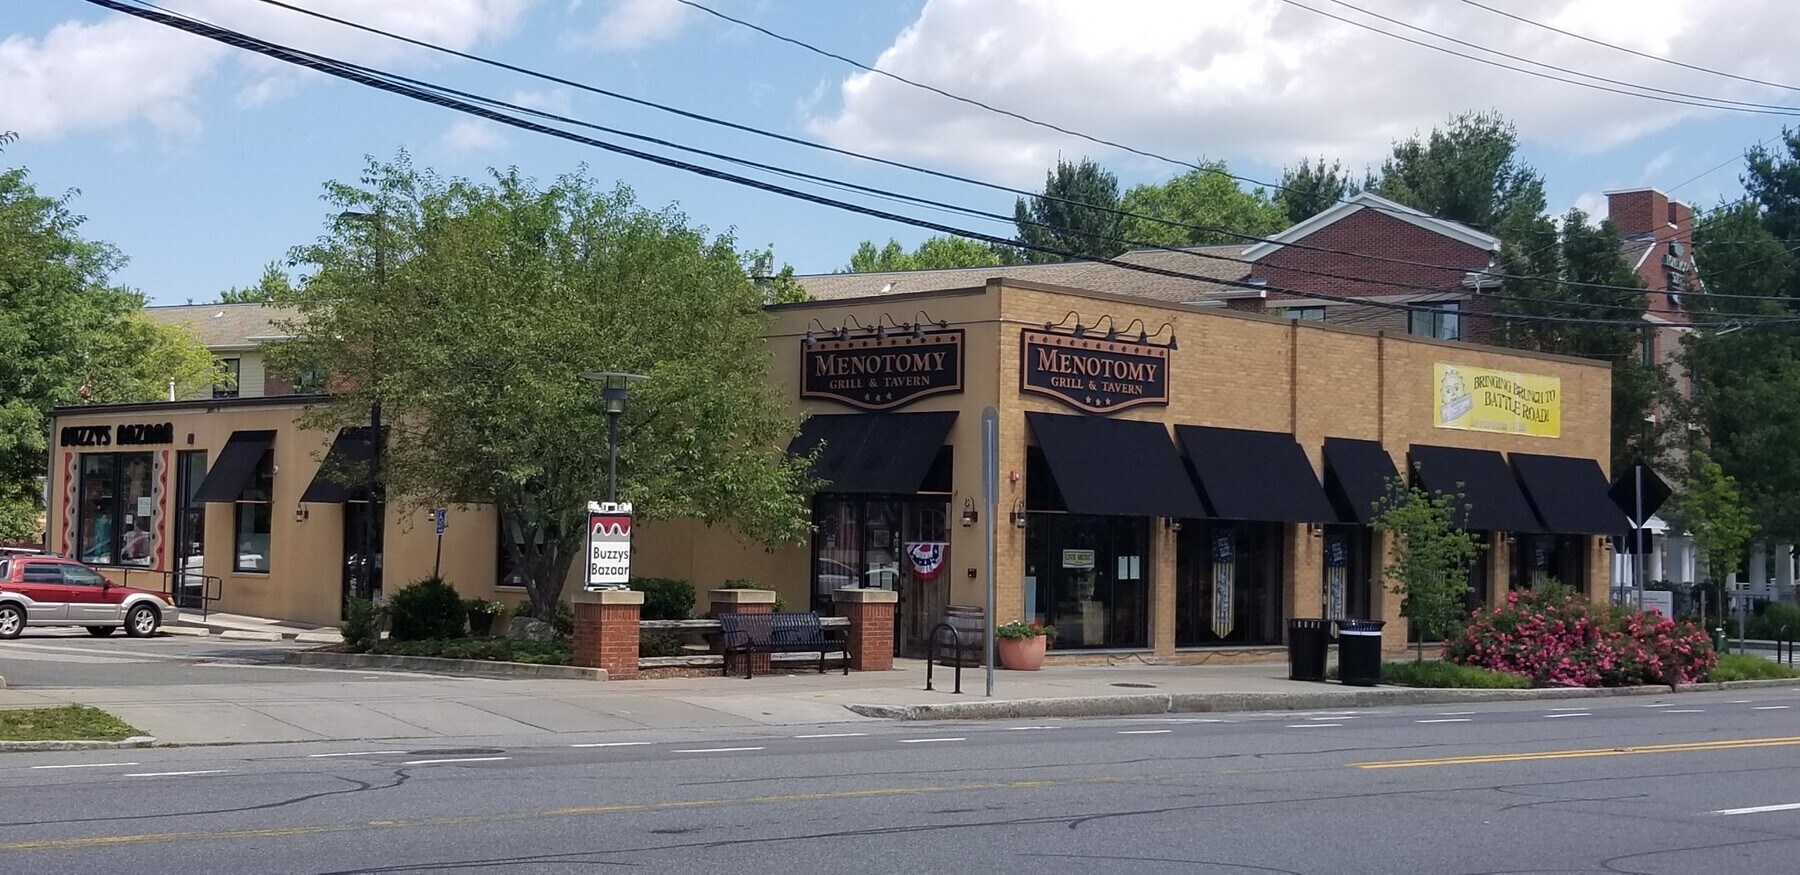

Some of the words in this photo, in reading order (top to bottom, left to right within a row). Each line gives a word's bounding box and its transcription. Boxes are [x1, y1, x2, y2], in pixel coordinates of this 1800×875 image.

[815, 352, 946, 376] MENOTOMY
[1037, 348, 1157, 382] MENOTOMY
[829, 378, 864, 389] GRILL
[869, 378, 878, 388] &
[883, 376, 930, 386] TAVERN
[1051, 376, 1084, 390] GRILL
[1088, 380, 1097, 391] &
[1101, 381, 1143, 395] TAVERN
[1473, 375, 1511, 393] BRINGING
[1513, 382, 1544, 404] BRUNCH
[1545, 389, 1556, 403] TO
[1484, 391, 1521, 416] BATTLE
[1522, 405, 1549, 423] ROAD!
[60, 426, 111, 446] BUZZYS
[116, 422, 173, 444] BAZAAR
[593, 547, 629, 562] Buzzys
[591, 563, 629, 575] Bazaar
